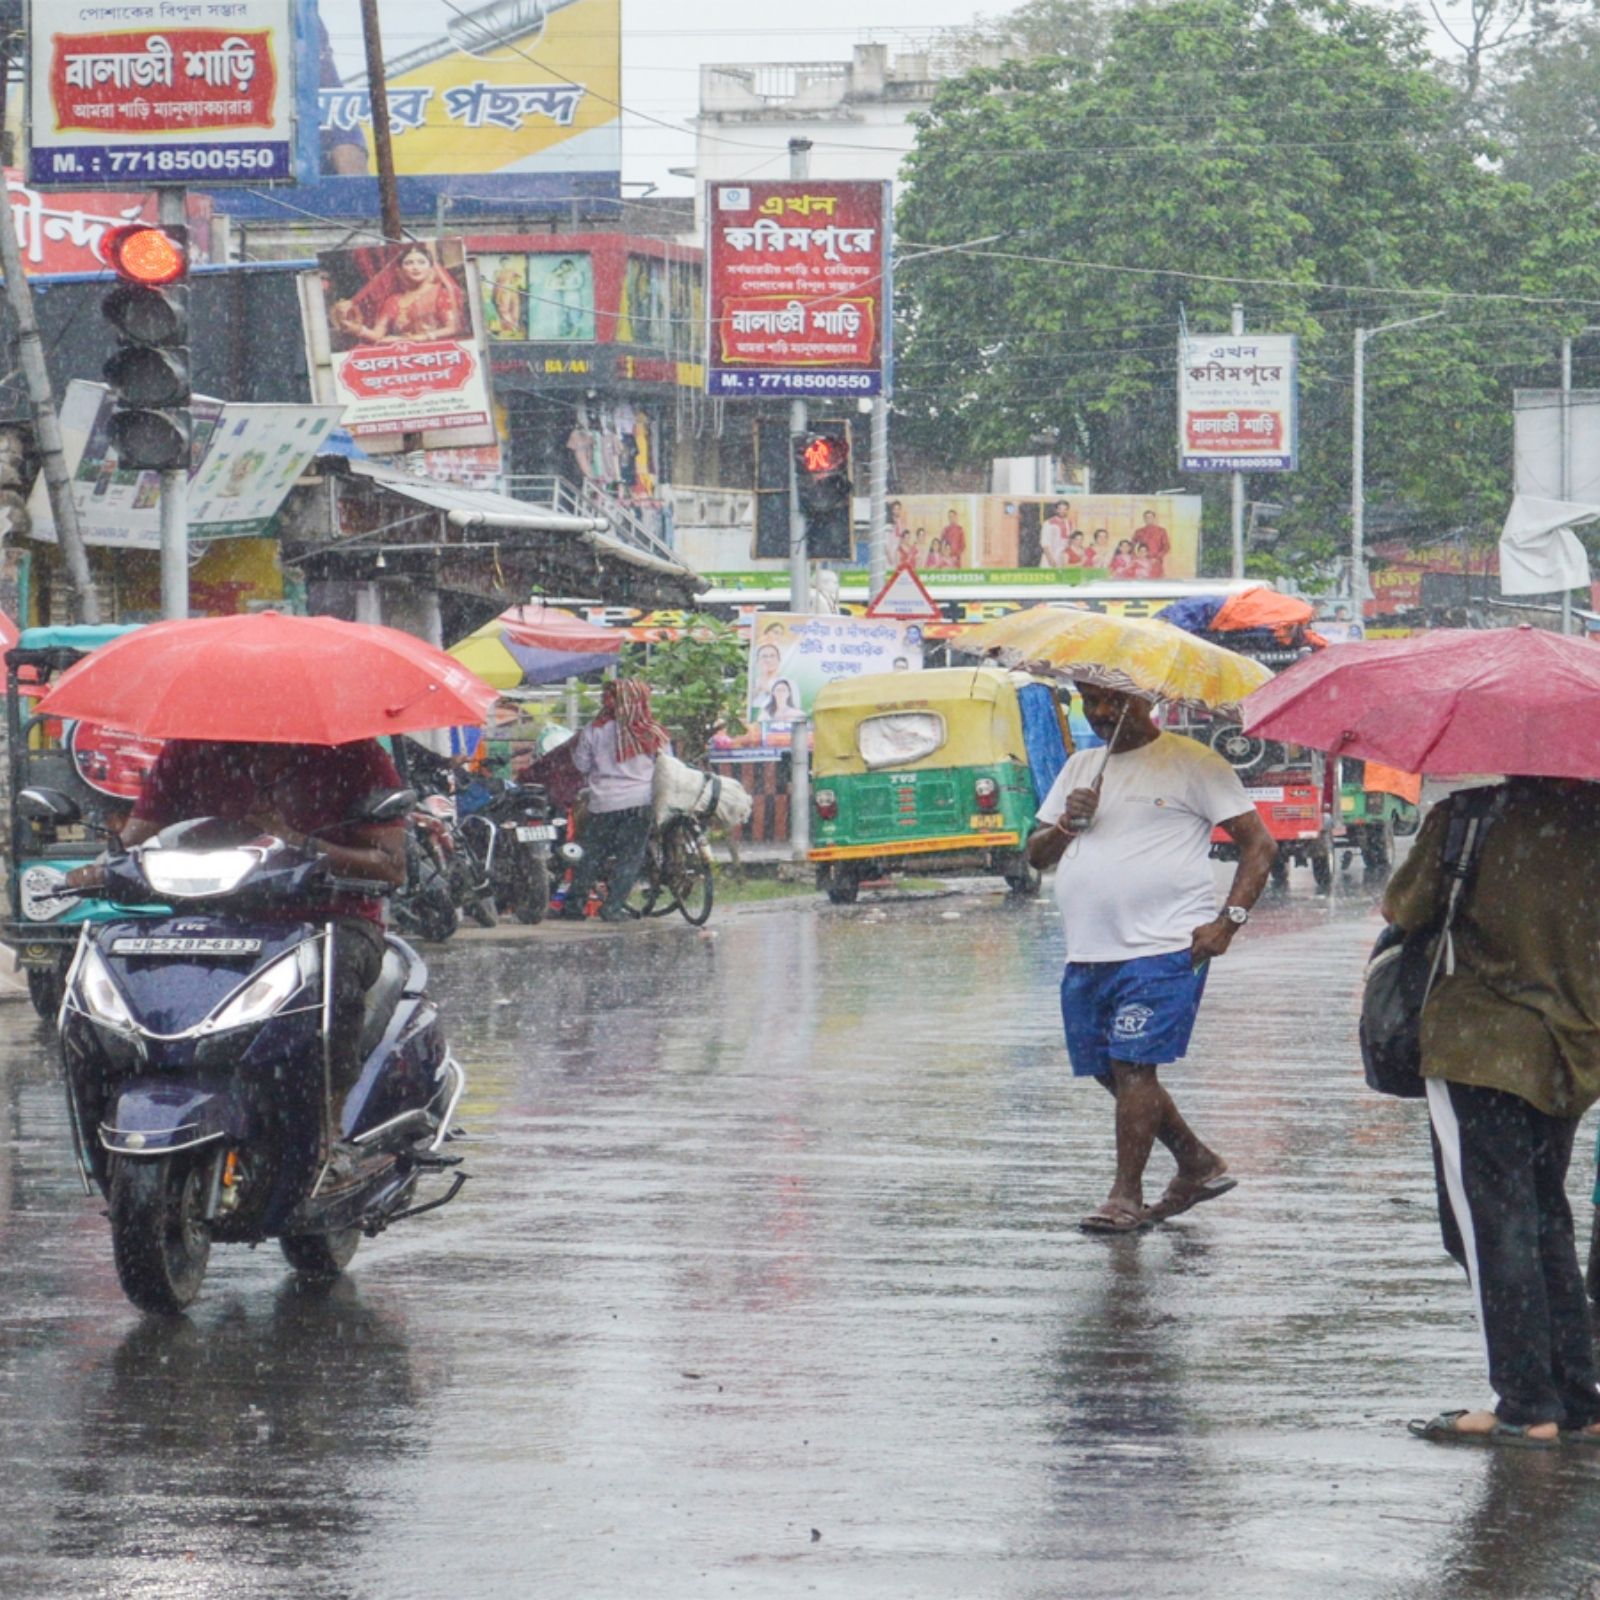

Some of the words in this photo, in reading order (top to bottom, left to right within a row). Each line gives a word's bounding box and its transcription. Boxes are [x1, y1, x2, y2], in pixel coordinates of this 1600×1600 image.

[65, 35, 173, 89] বালাজী
[183, 37, 256, 93] শাড়ি
[72, 102, 114, 119] আমরা
[118, 98, 149, 121] শাড়ি
[442, 80, 585, 130] পছন্দ
[53, 153, 84, 172] M.
[109, 149, 273, 171] 7718500550
[759, 194, 837, 216] এখন
[723, 219, 875, 262] করিমপুরে
[732, 300, 805, 334] বালাজী
[812, 303, 861, 338] শাড়ি
[352, 350, 461, 372] অলংকার
[1210, 345, 1258, 358] এখন
[759, 374, 870, 388] 7718500550
[1187, 361, 1282, 387] করিমপুরে
[889, 774, 917, 784] TVS
